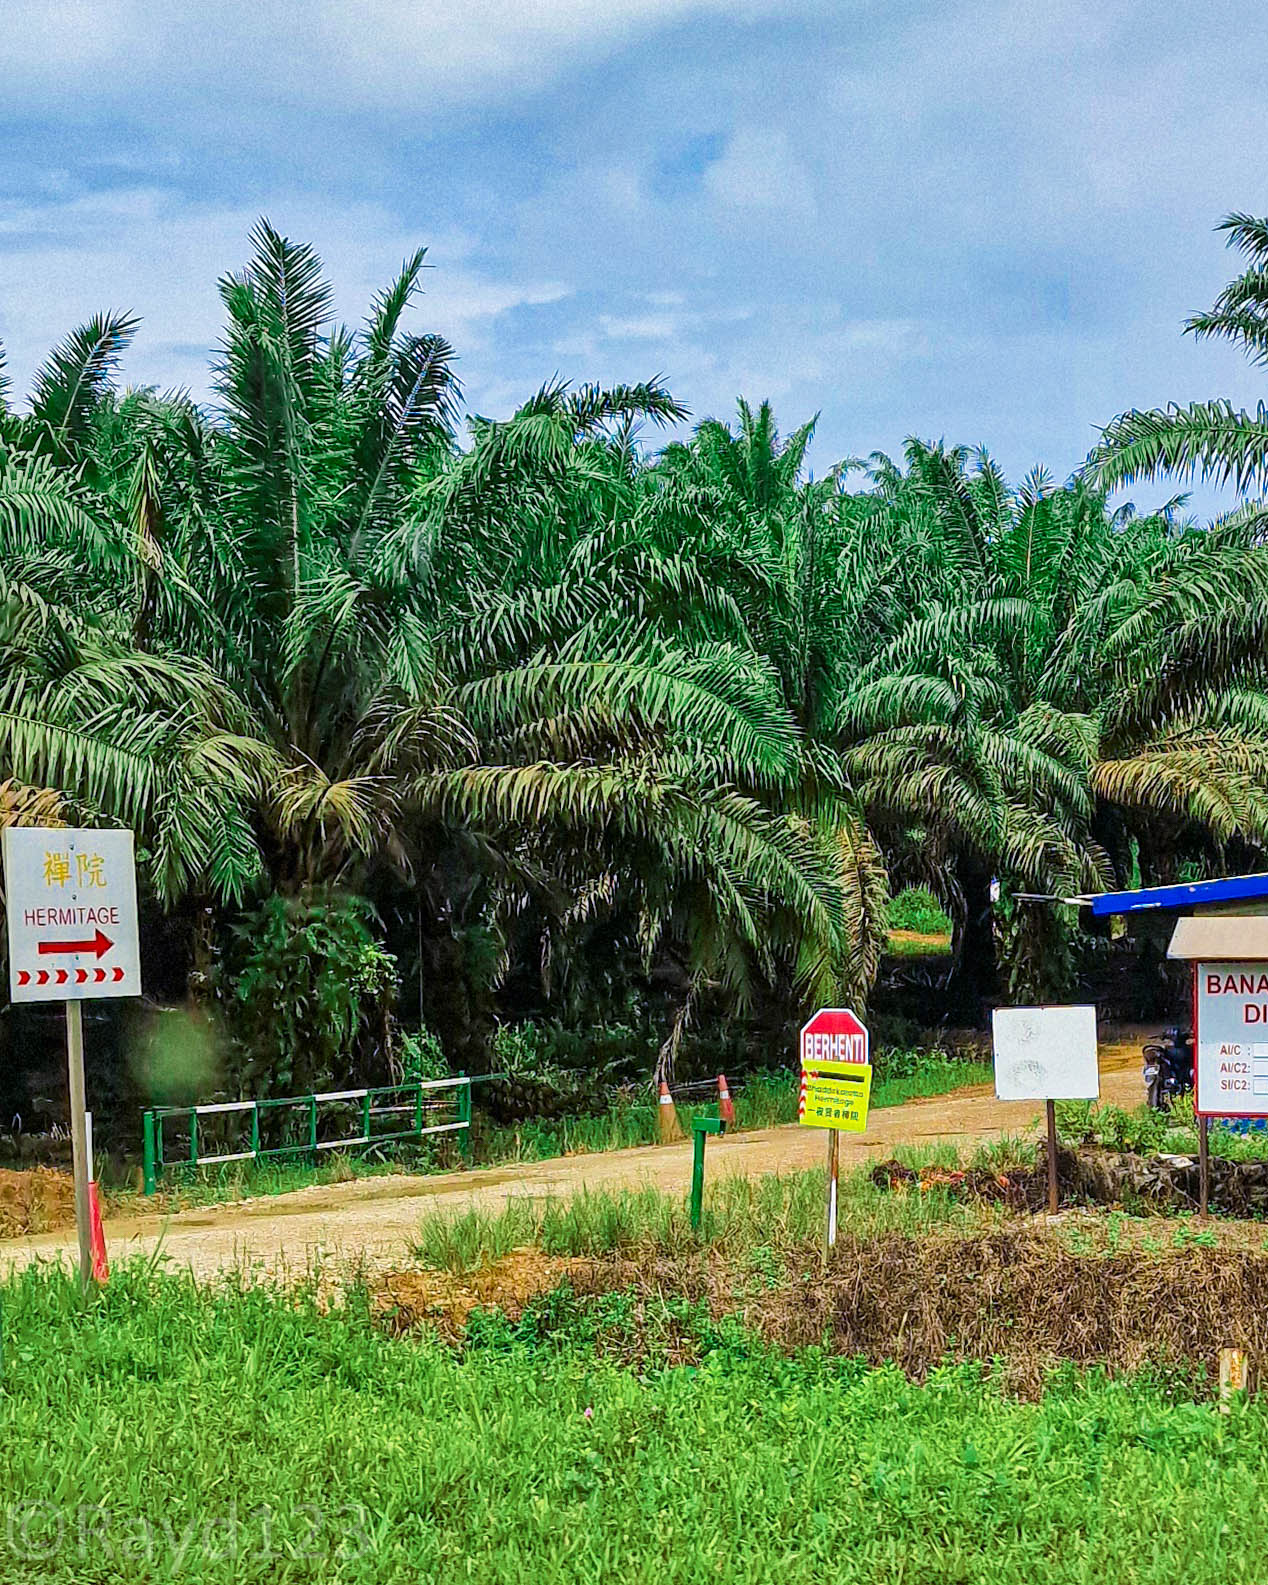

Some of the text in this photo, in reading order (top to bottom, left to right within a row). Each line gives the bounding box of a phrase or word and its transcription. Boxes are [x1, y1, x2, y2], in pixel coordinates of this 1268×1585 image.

[43, 851, 107, 888] 禪院
[24, 907, 120, 926] HERMITAGE
[805, 1033, 864, 1062] BERHENTI
